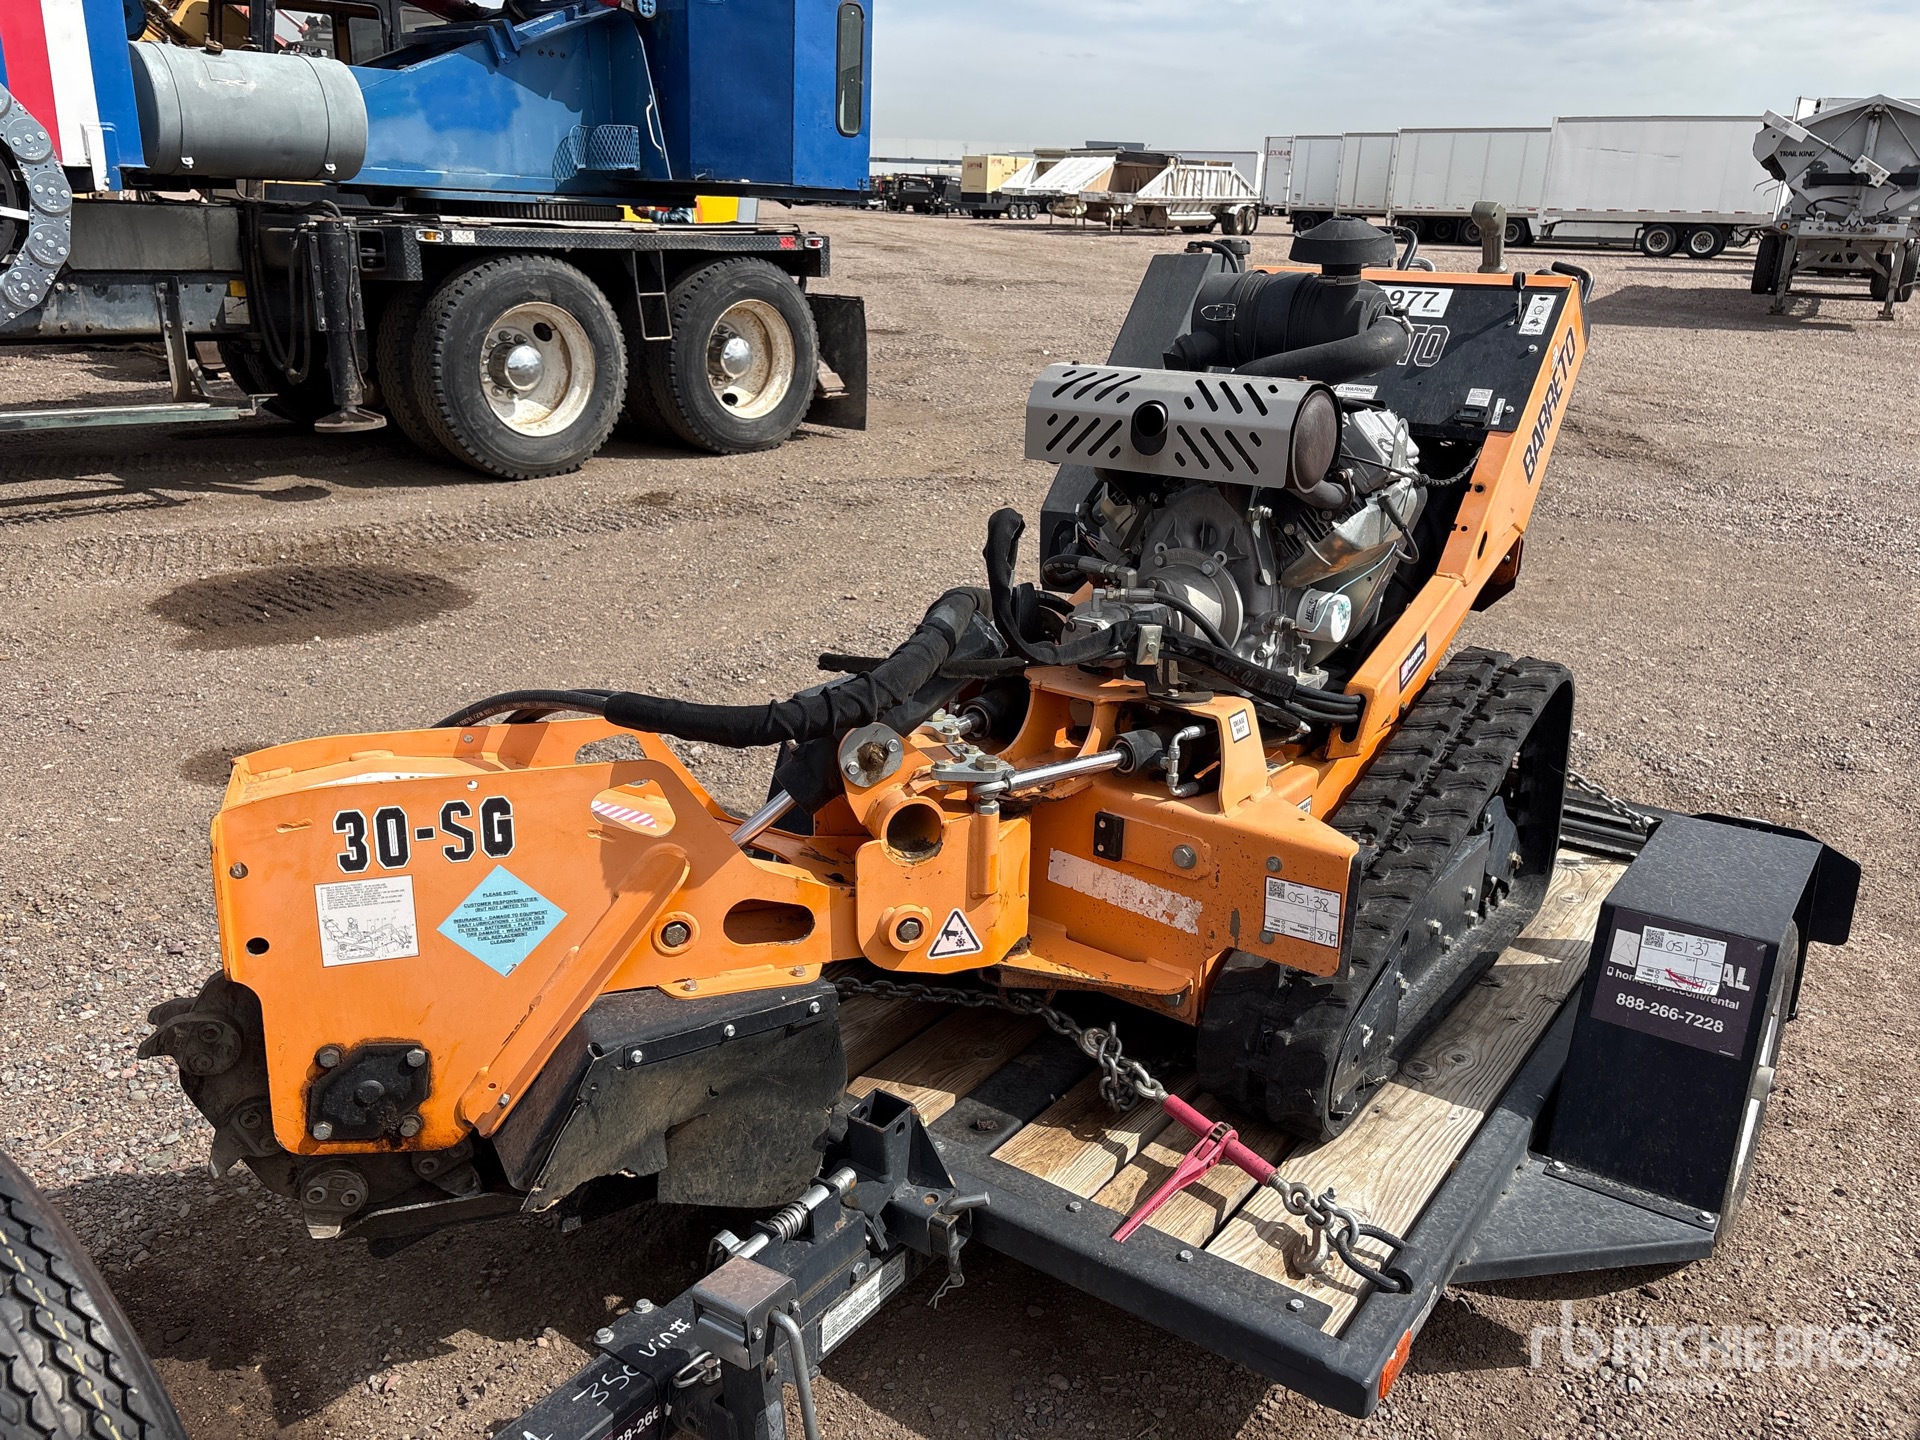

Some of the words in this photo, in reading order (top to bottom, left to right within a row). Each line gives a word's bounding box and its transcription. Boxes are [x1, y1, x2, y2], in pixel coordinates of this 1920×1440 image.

[1522, 326, 1576, 485] BARRETO
[332, 795, 516, 874] 30-SG
[453, 916, 482, 924] INSURANCE
[1615, 992, 1724, 1034] 888-266-7228
